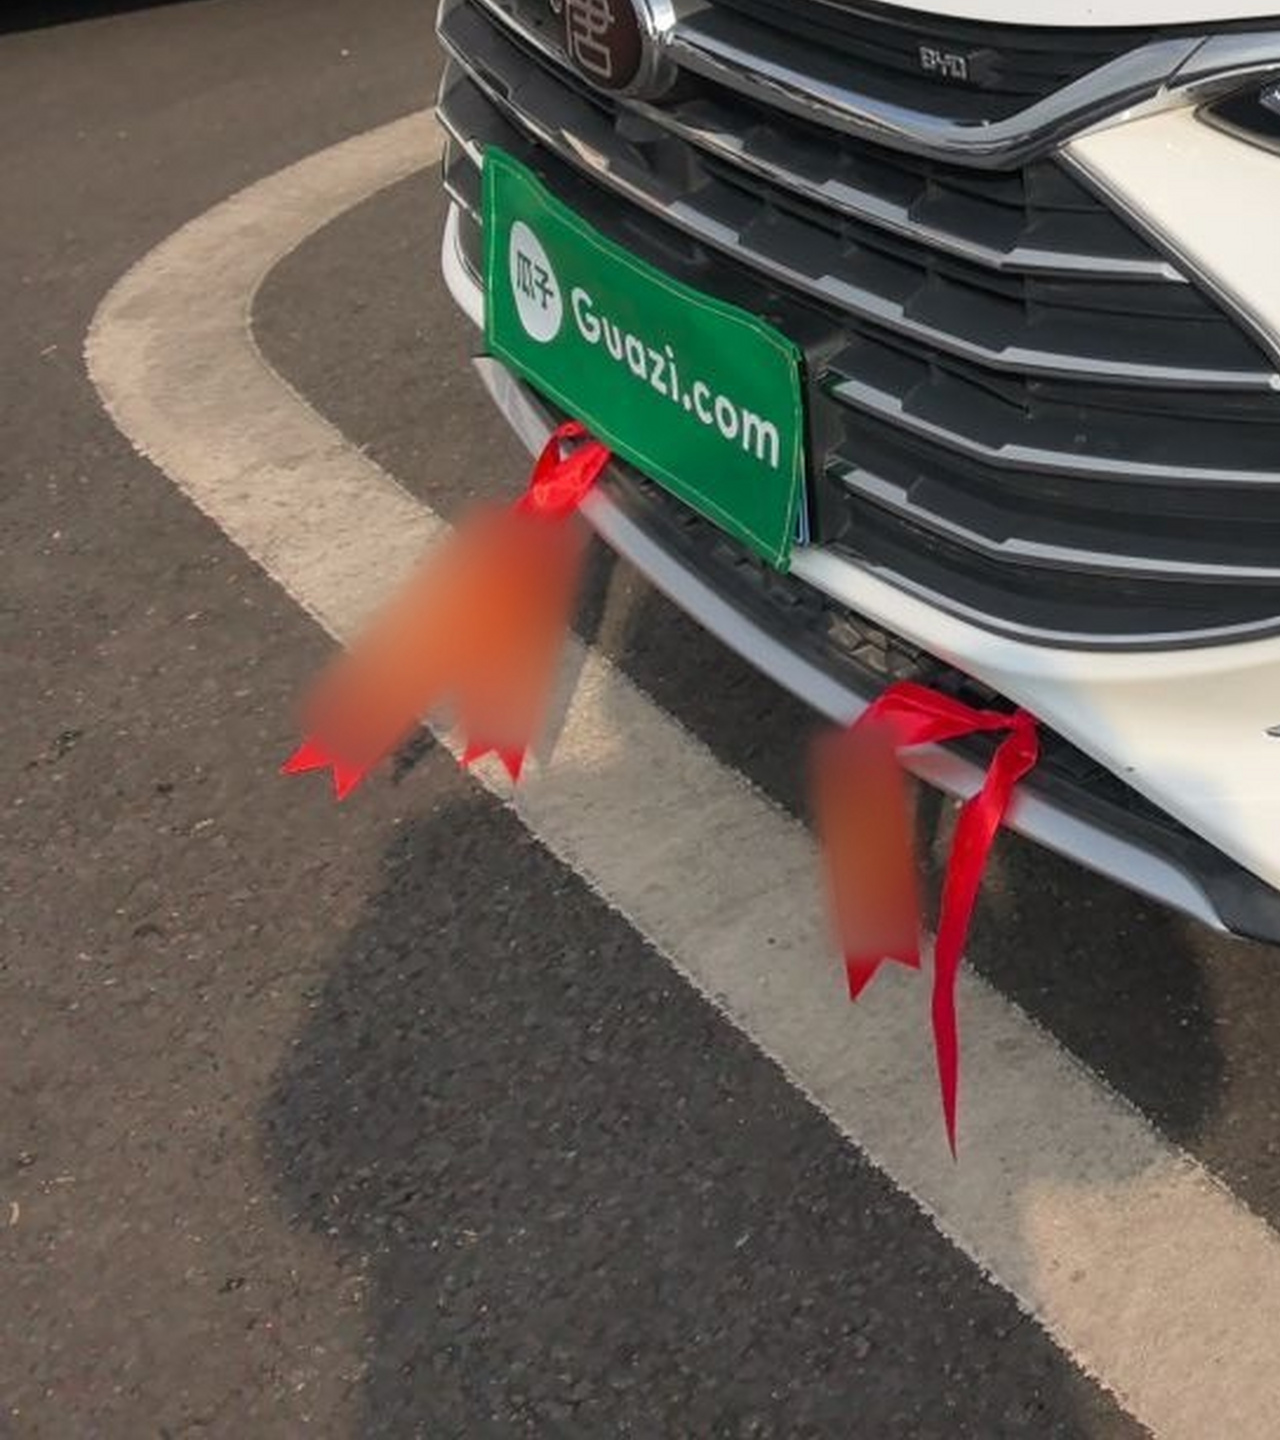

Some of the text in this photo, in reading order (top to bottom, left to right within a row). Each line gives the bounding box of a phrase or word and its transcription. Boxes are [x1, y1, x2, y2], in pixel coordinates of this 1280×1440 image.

[920, 46, 967, 80] BYD
[516, 250, 554, 310] 瓜子
[571, 287, 781, 469] Guazi.com
